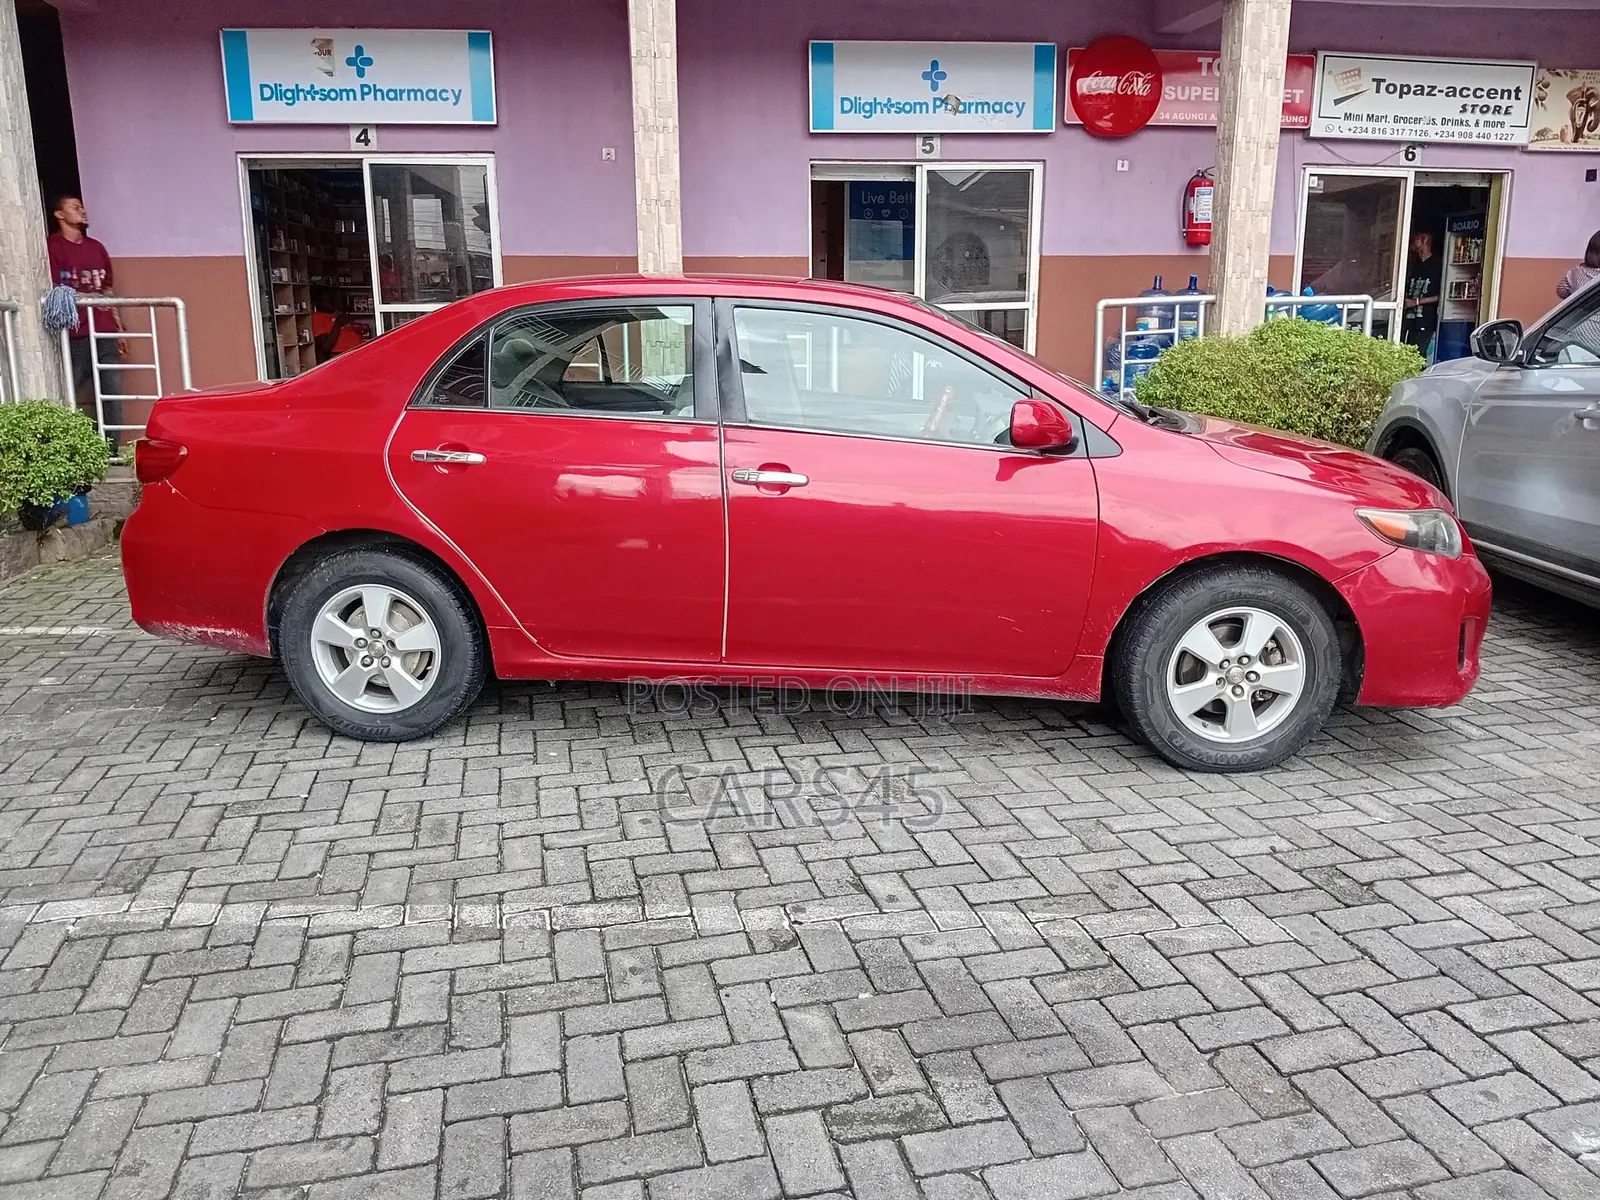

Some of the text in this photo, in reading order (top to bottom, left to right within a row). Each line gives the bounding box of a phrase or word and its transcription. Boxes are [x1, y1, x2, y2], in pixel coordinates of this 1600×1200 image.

[259, 83, 462, 106] Dlightsom Pharmacy
[1371, 78, 1522, 101] Topaz-accent
[840, 97, 929, 119] Dlightsom
[1459, 104, 1514, 116] STORE
[1160, 112, 1170, 120] 34
[1172, 112, 1208, 121] AGUNGI
[1281, 115, 1308, 123] GUNGI
[1343, 112, 1364, 122] Mini
[1474, 118, 1480, 128] &
[1483, 120, 1506, 129] more
[355, 128, 371, 147] 4
[1347, 126, 1369, 134] +234
[1371, 127, 1387, 135] 816
[1389, 127, 1406, 136] 317
[1434, 130, 1455, 138] +234
[1457, 131, 1473, 139] 908
[1475, 132, 1491, 140] 440
[1494, 133, 1515, 141] 1227
[921, 136, 934, 154] 5
[1404, 145, 1416, 162] 6
[861, 190, 885, 204] Live
